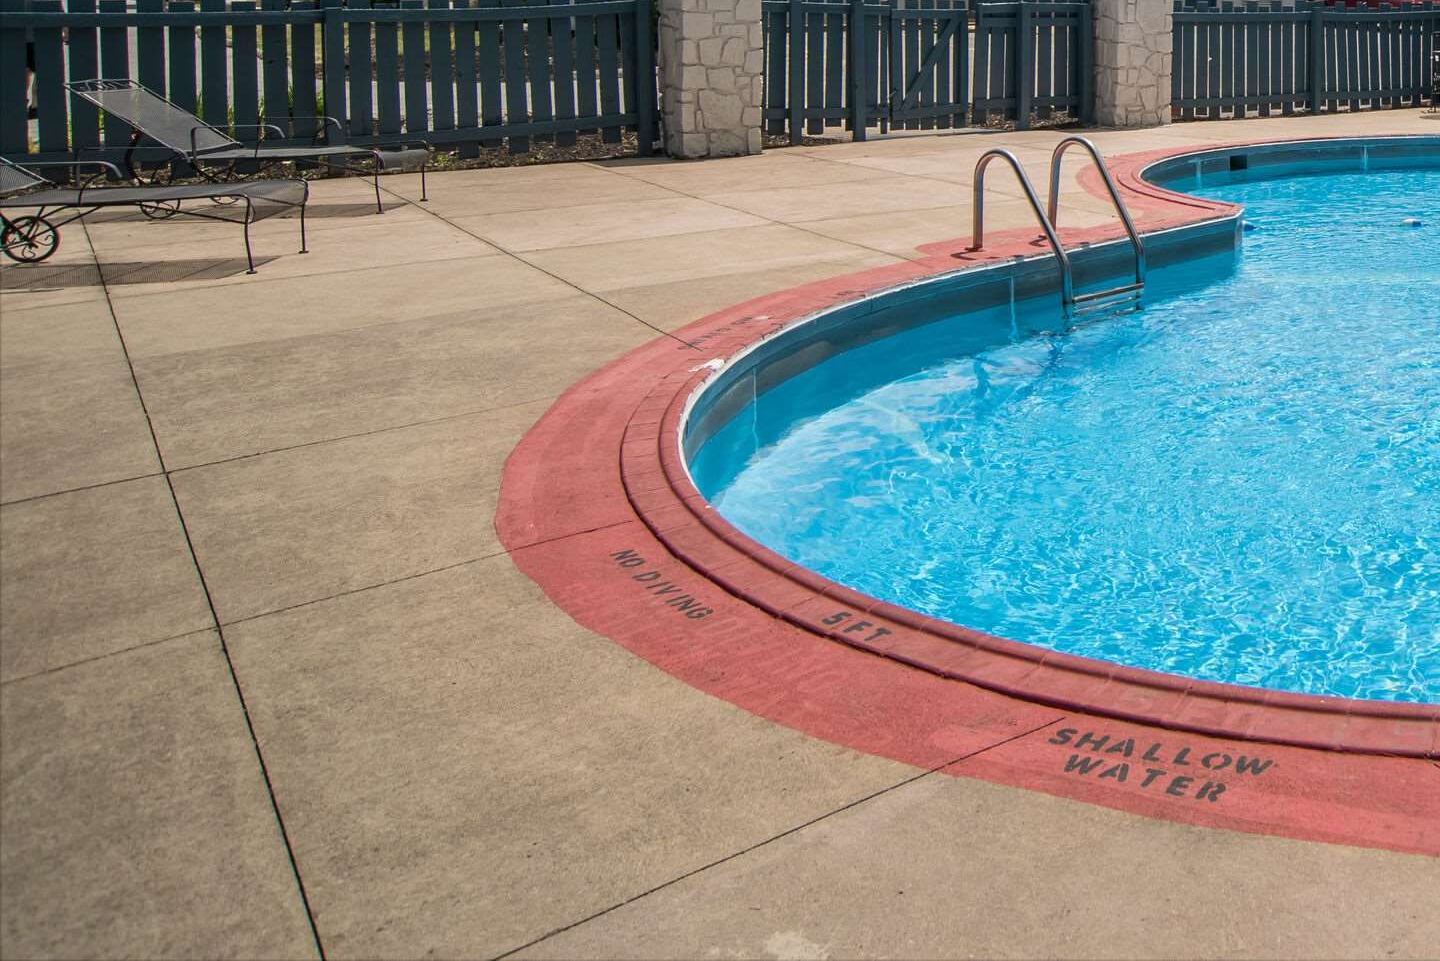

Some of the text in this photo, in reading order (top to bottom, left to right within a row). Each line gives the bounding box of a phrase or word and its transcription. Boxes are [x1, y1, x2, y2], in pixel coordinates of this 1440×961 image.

[610, 549, 714, 620] NO DIVING
[1048, 728, 1274, 776] SHALLOW
[1064, 754, 1227, 802] WATER
